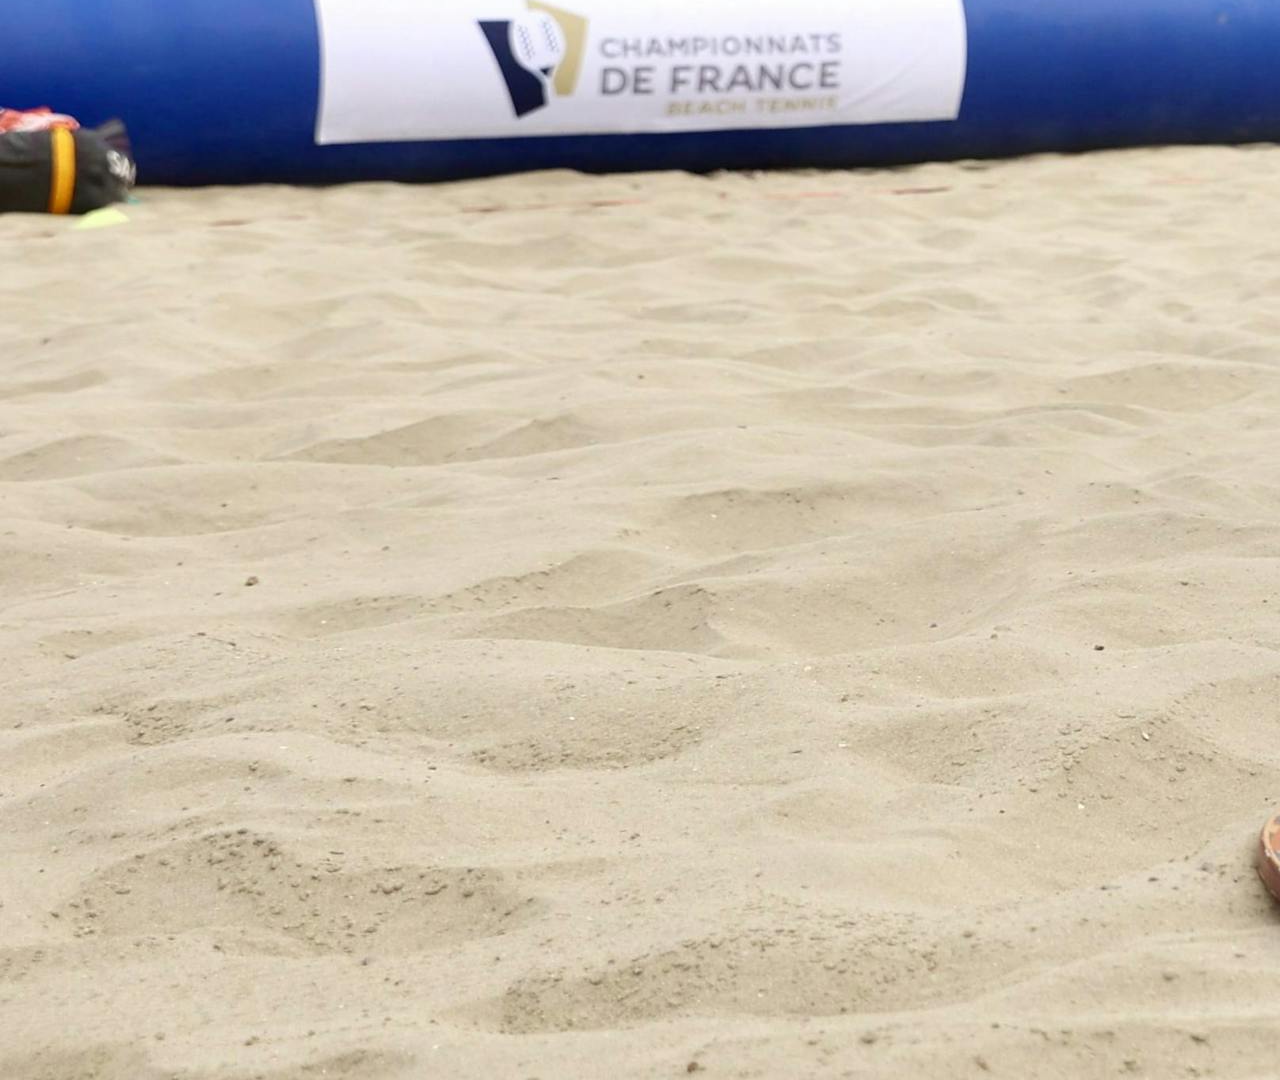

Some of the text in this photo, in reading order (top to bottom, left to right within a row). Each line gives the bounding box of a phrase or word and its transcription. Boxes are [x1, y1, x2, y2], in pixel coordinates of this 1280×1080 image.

[600, 32, 842, 59] CHAMPIONNATS
[600, 61, 841, 96] DE FRANCE
[666, 94, 839, 116] BEACH TENNIS
